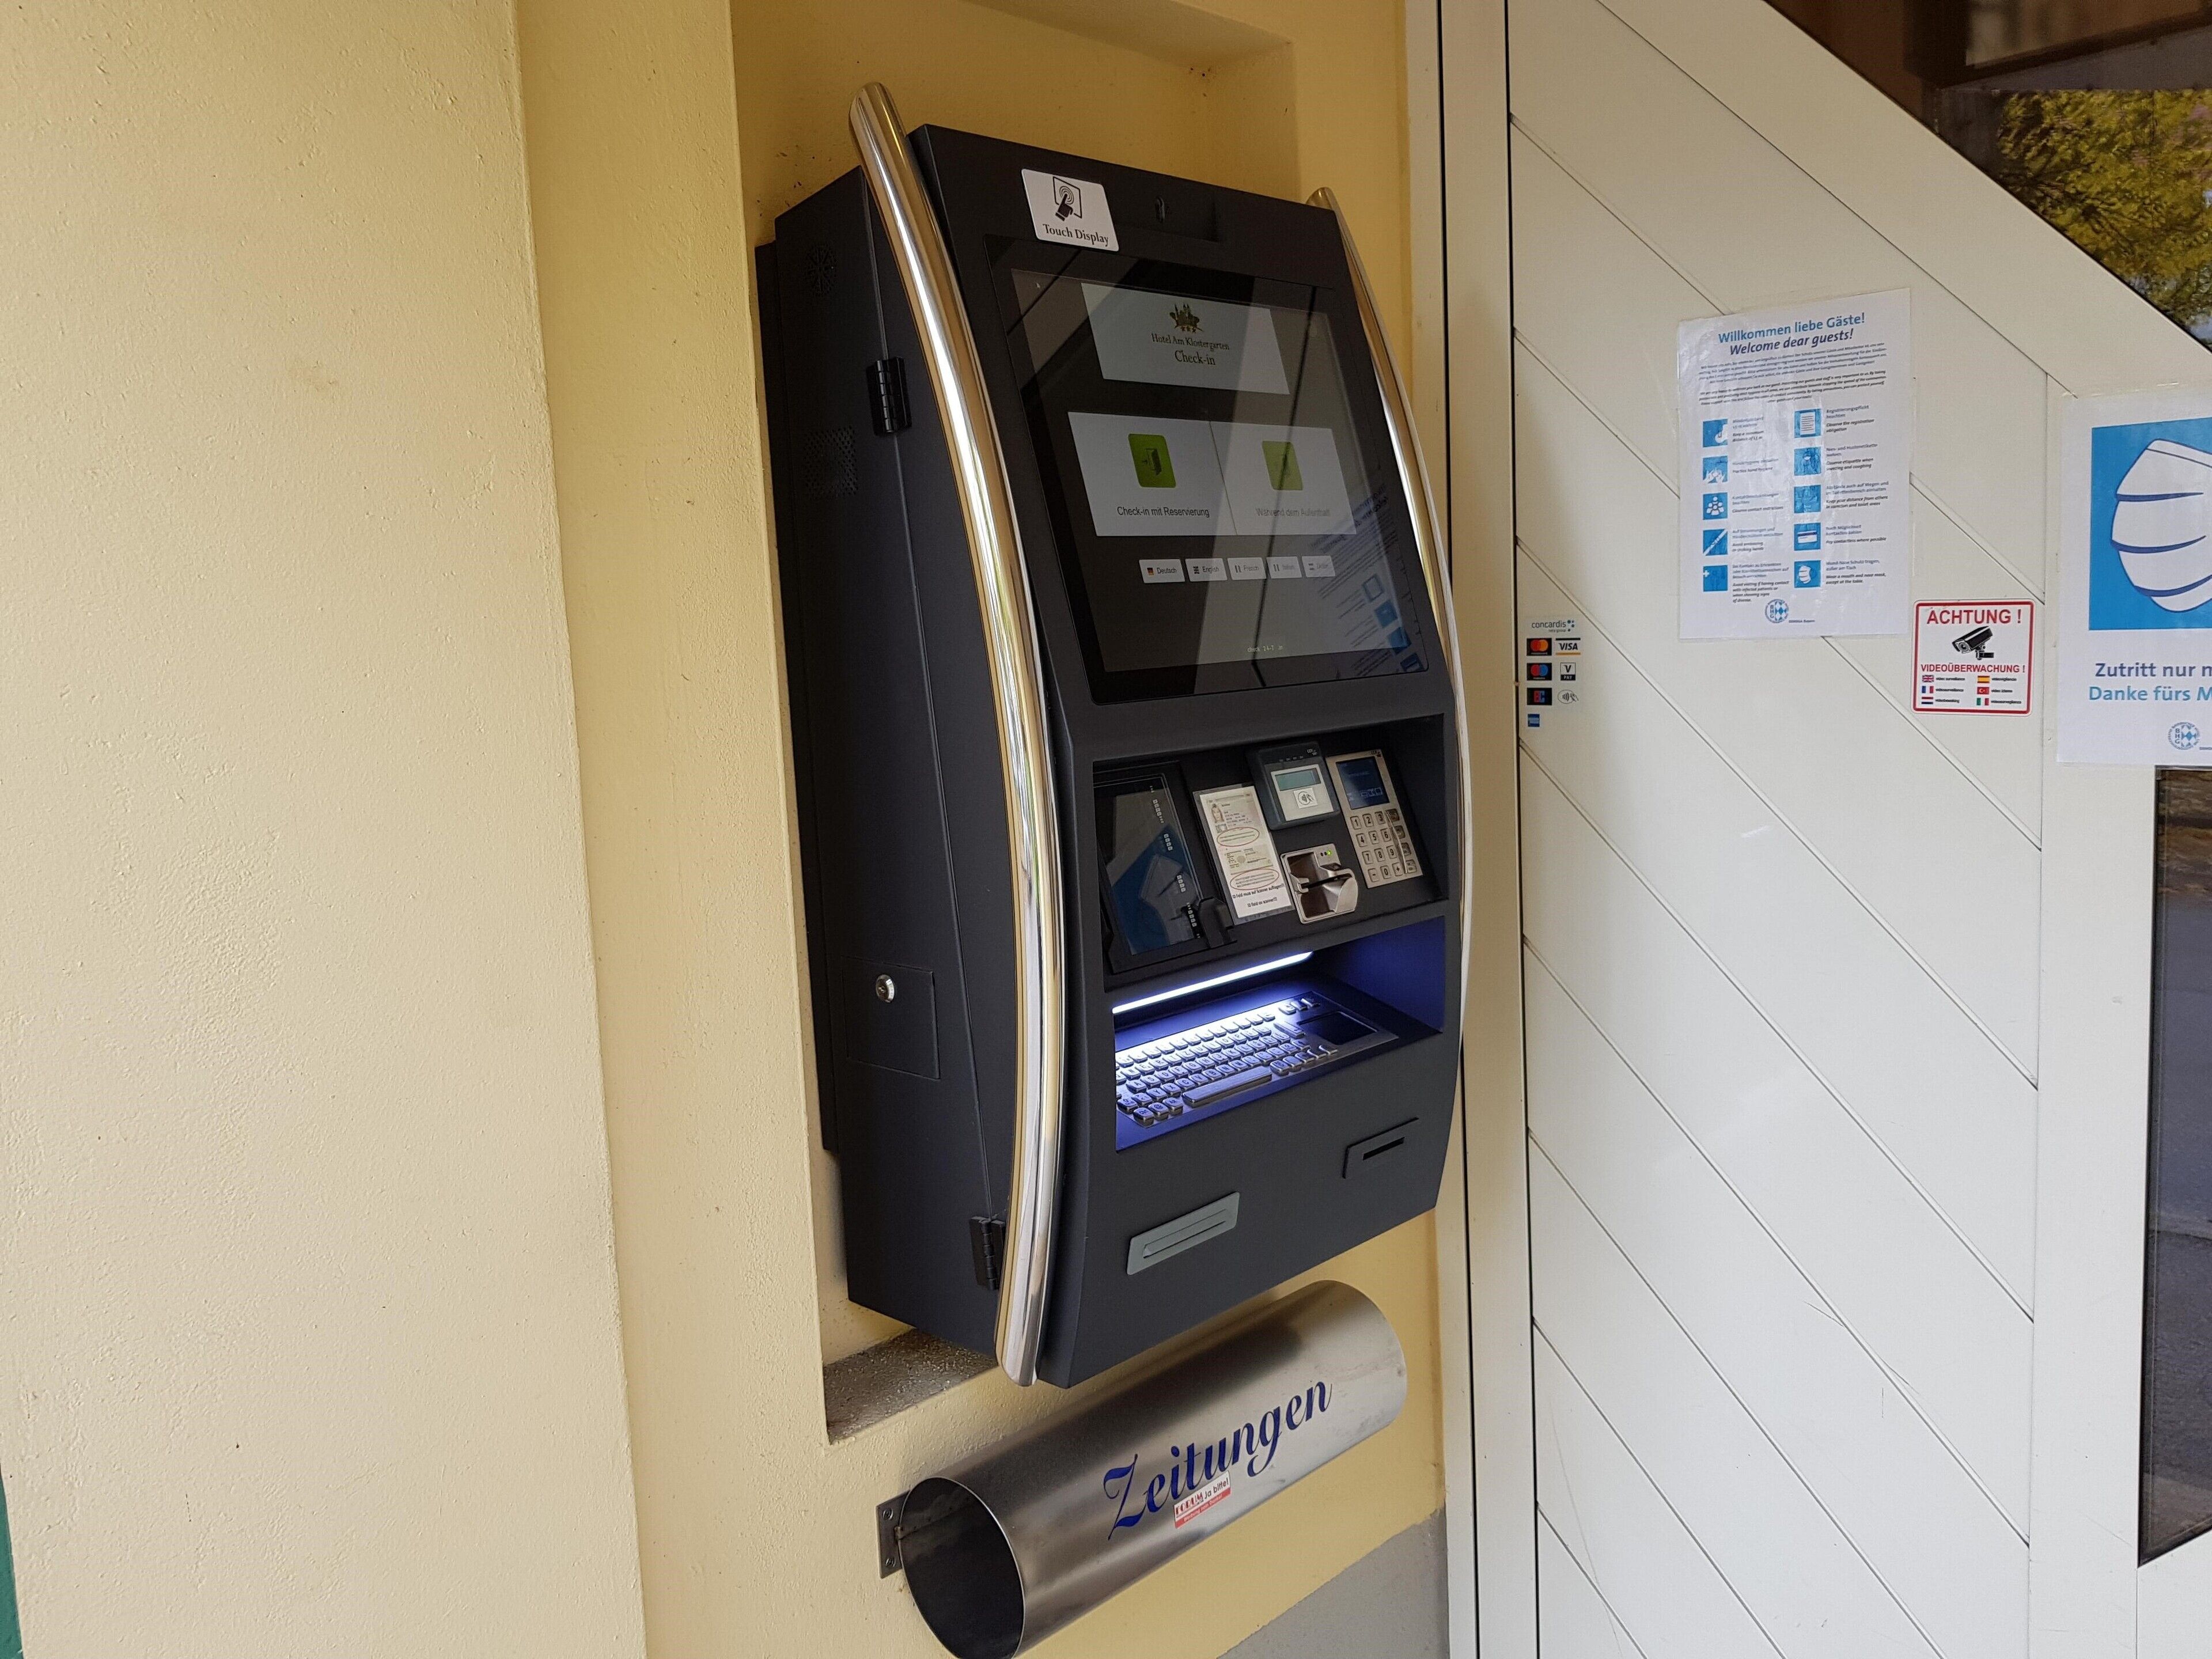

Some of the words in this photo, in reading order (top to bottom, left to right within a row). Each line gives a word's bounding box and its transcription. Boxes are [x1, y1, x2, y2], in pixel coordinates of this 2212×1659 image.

[1043, 224, 1073, 238] Touch
[1075, 229, 1109, 247] Display
[1718, 324, 1791, 343] Willkommen
[1795, 321, 1823, 333] liebe
[1827, 312, 1865, 328] Gäste!
[1152, 333, 1171, 343] Hotel
[1172, 336, 1185, 345] Am
[1730, 341, 1781, 355] Welcome
[1783, 336, 1810, 349] dear
[1811, 328, 1854, 348] guests!
[1175, 350, 1216, 365] Check-in
[1118, 506, 1150, 517] Check-in
[1151, 507, 1162, 516] mit
[1164, 507, 1210, 518] Reservierung
[1202, 566, 1220, 574] English
[1531, 620, 1566, 628] concardis
[1927, 609, 2012, 624] ACHTUNG
[2017, 609, 2021, 624] !
[1564, 665, 1571, 673] V
[1921, 662, 2020, 673] VIDEOÜBERWACHUNG
[2022, 665, 2025, 673] !
[2094, 662, 2157, 677] Zutritt
[2162, 666, 2196, 677] nur
[2089, 685, 2148, 700] Danke
[2153, 685, 2191, 700] fürs
[1103, 1381, 1333, 1541] Zeitungen
[1205, 1490, 1211, 1499] Ja
